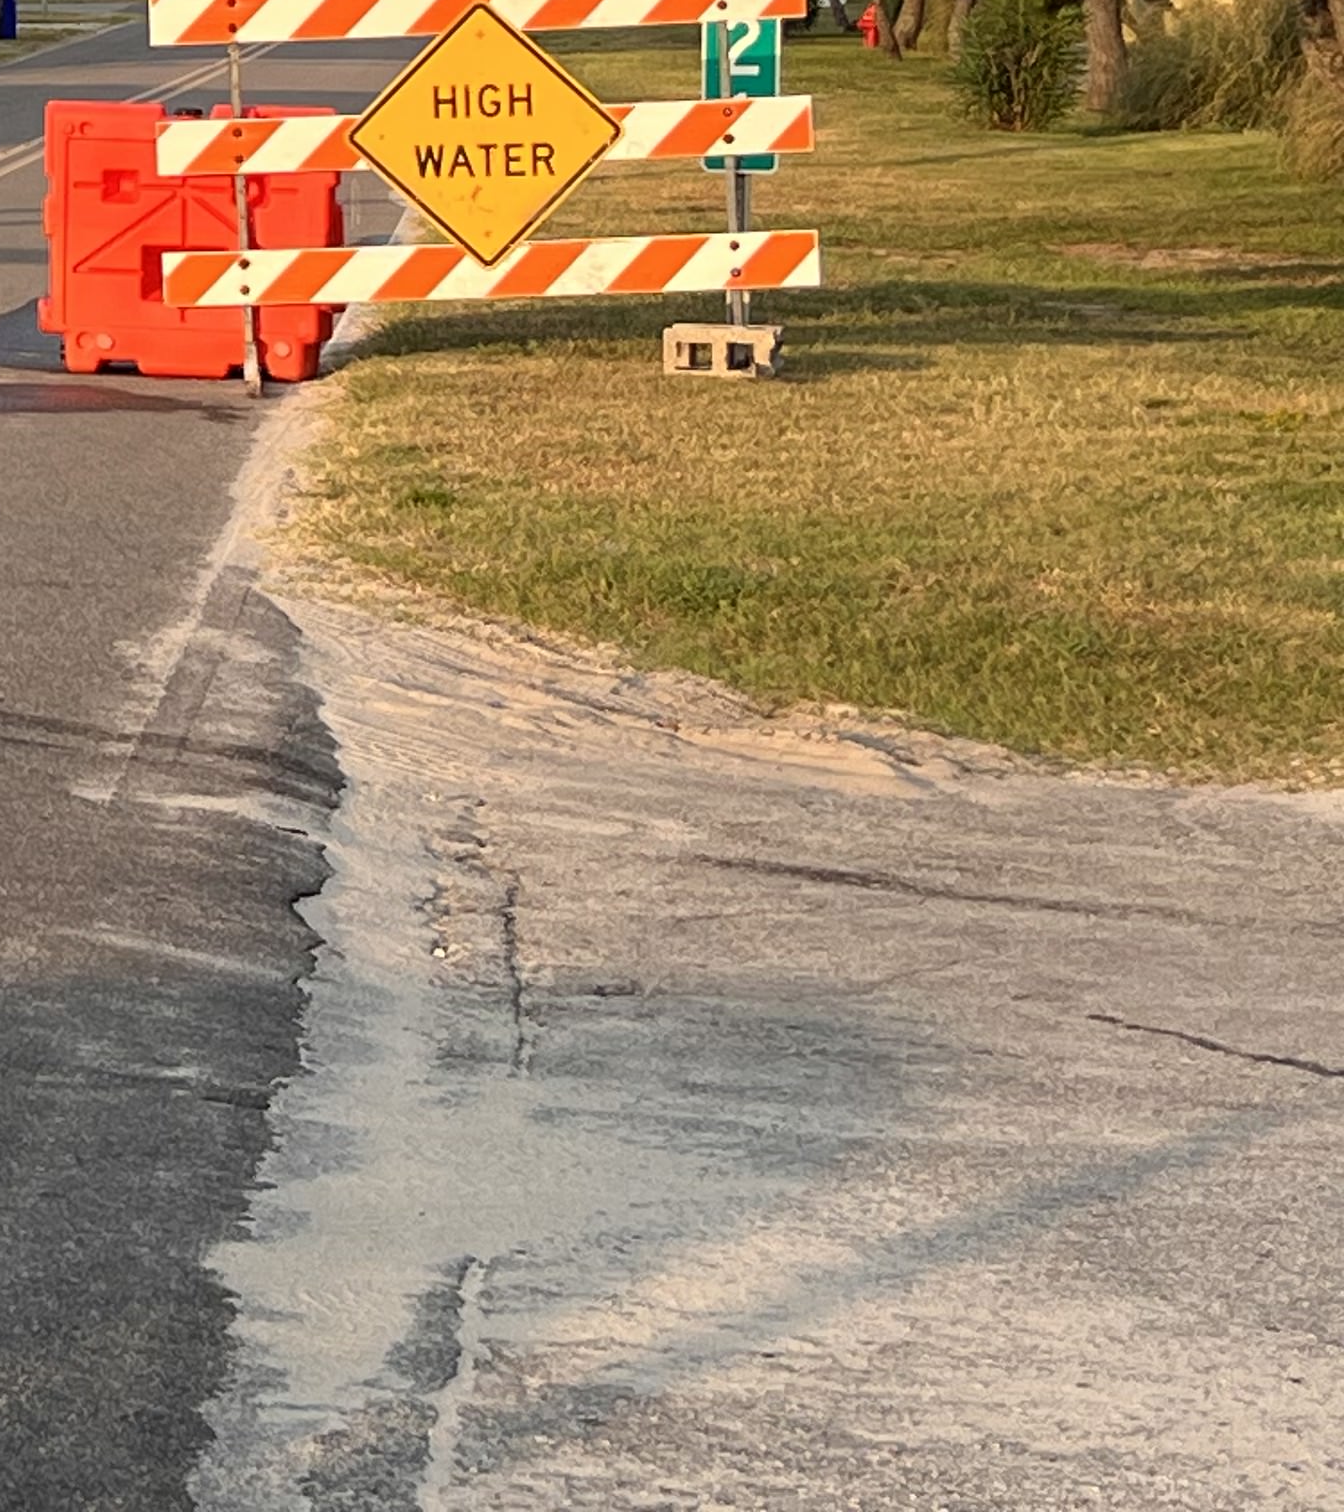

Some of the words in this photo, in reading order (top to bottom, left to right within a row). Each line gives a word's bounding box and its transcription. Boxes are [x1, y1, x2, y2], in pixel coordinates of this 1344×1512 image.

[726, 19, 761, 76] 2
[432, 83, 533, 119] HIGH
[414, 142, 556, 179] WATER
